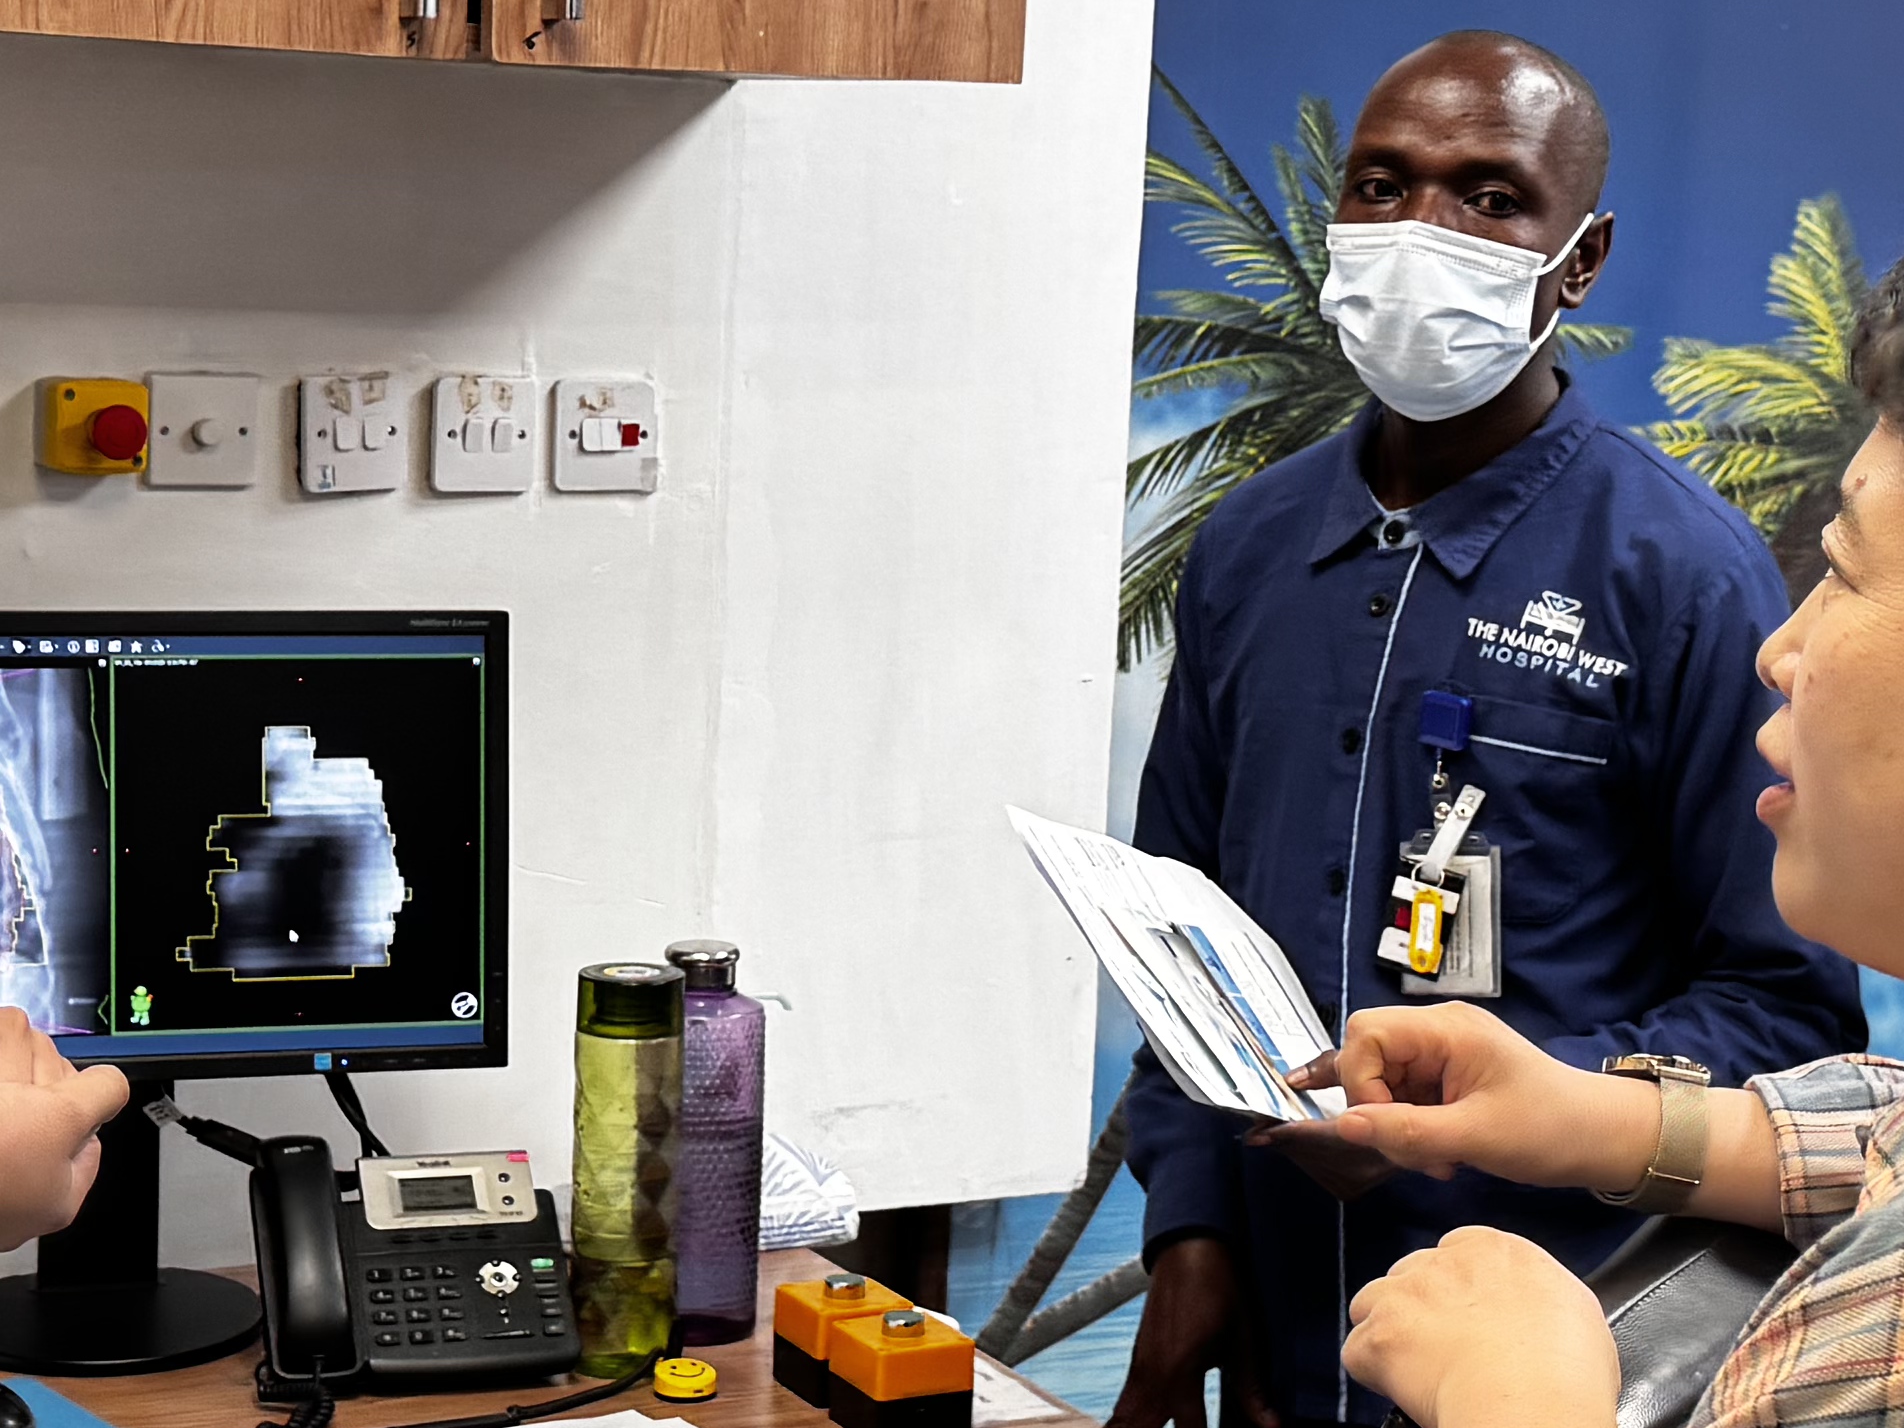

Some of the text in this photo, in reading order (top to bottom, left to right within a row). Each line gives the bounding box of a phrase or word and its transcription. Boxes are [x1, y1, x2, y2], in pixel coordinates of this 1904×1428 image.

[1467, 617, 1629, 676] THE NAIROBI WEST
[1479, 643, 1599, 688] HOSPITAL
